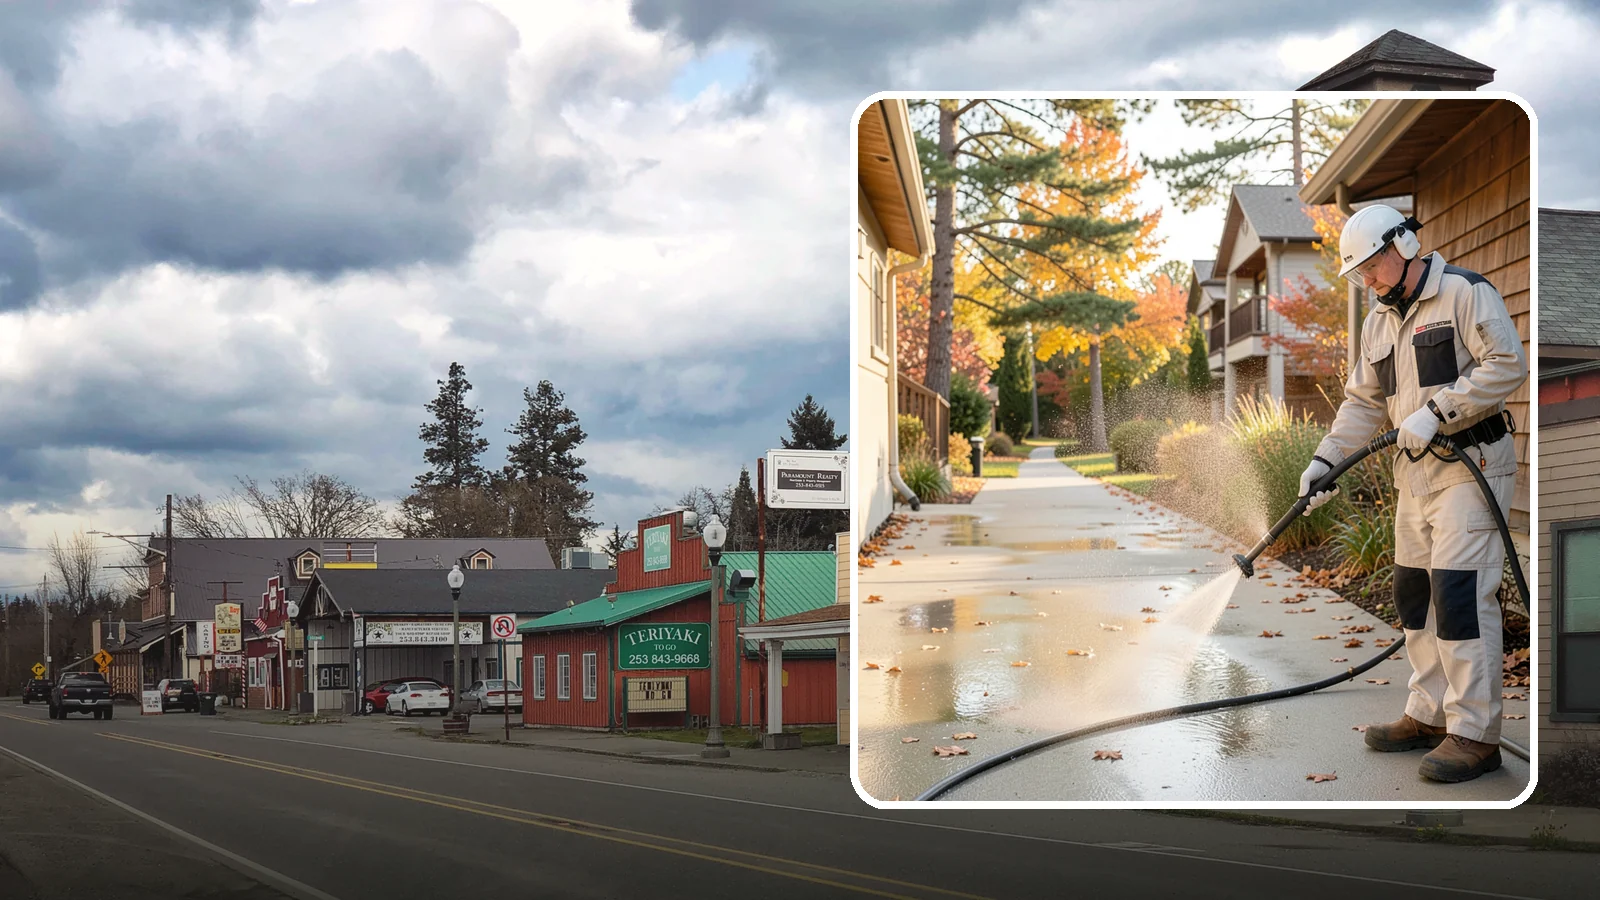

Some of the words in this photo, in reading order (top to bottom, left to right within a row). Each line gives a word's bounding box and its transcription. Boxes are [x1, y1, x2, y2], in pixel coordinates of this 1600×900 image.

[625, 627, 702, 646] TERIYAKI
[629, 654, 649, 665] 253
[651, 653, 700, 664] 843-9668
